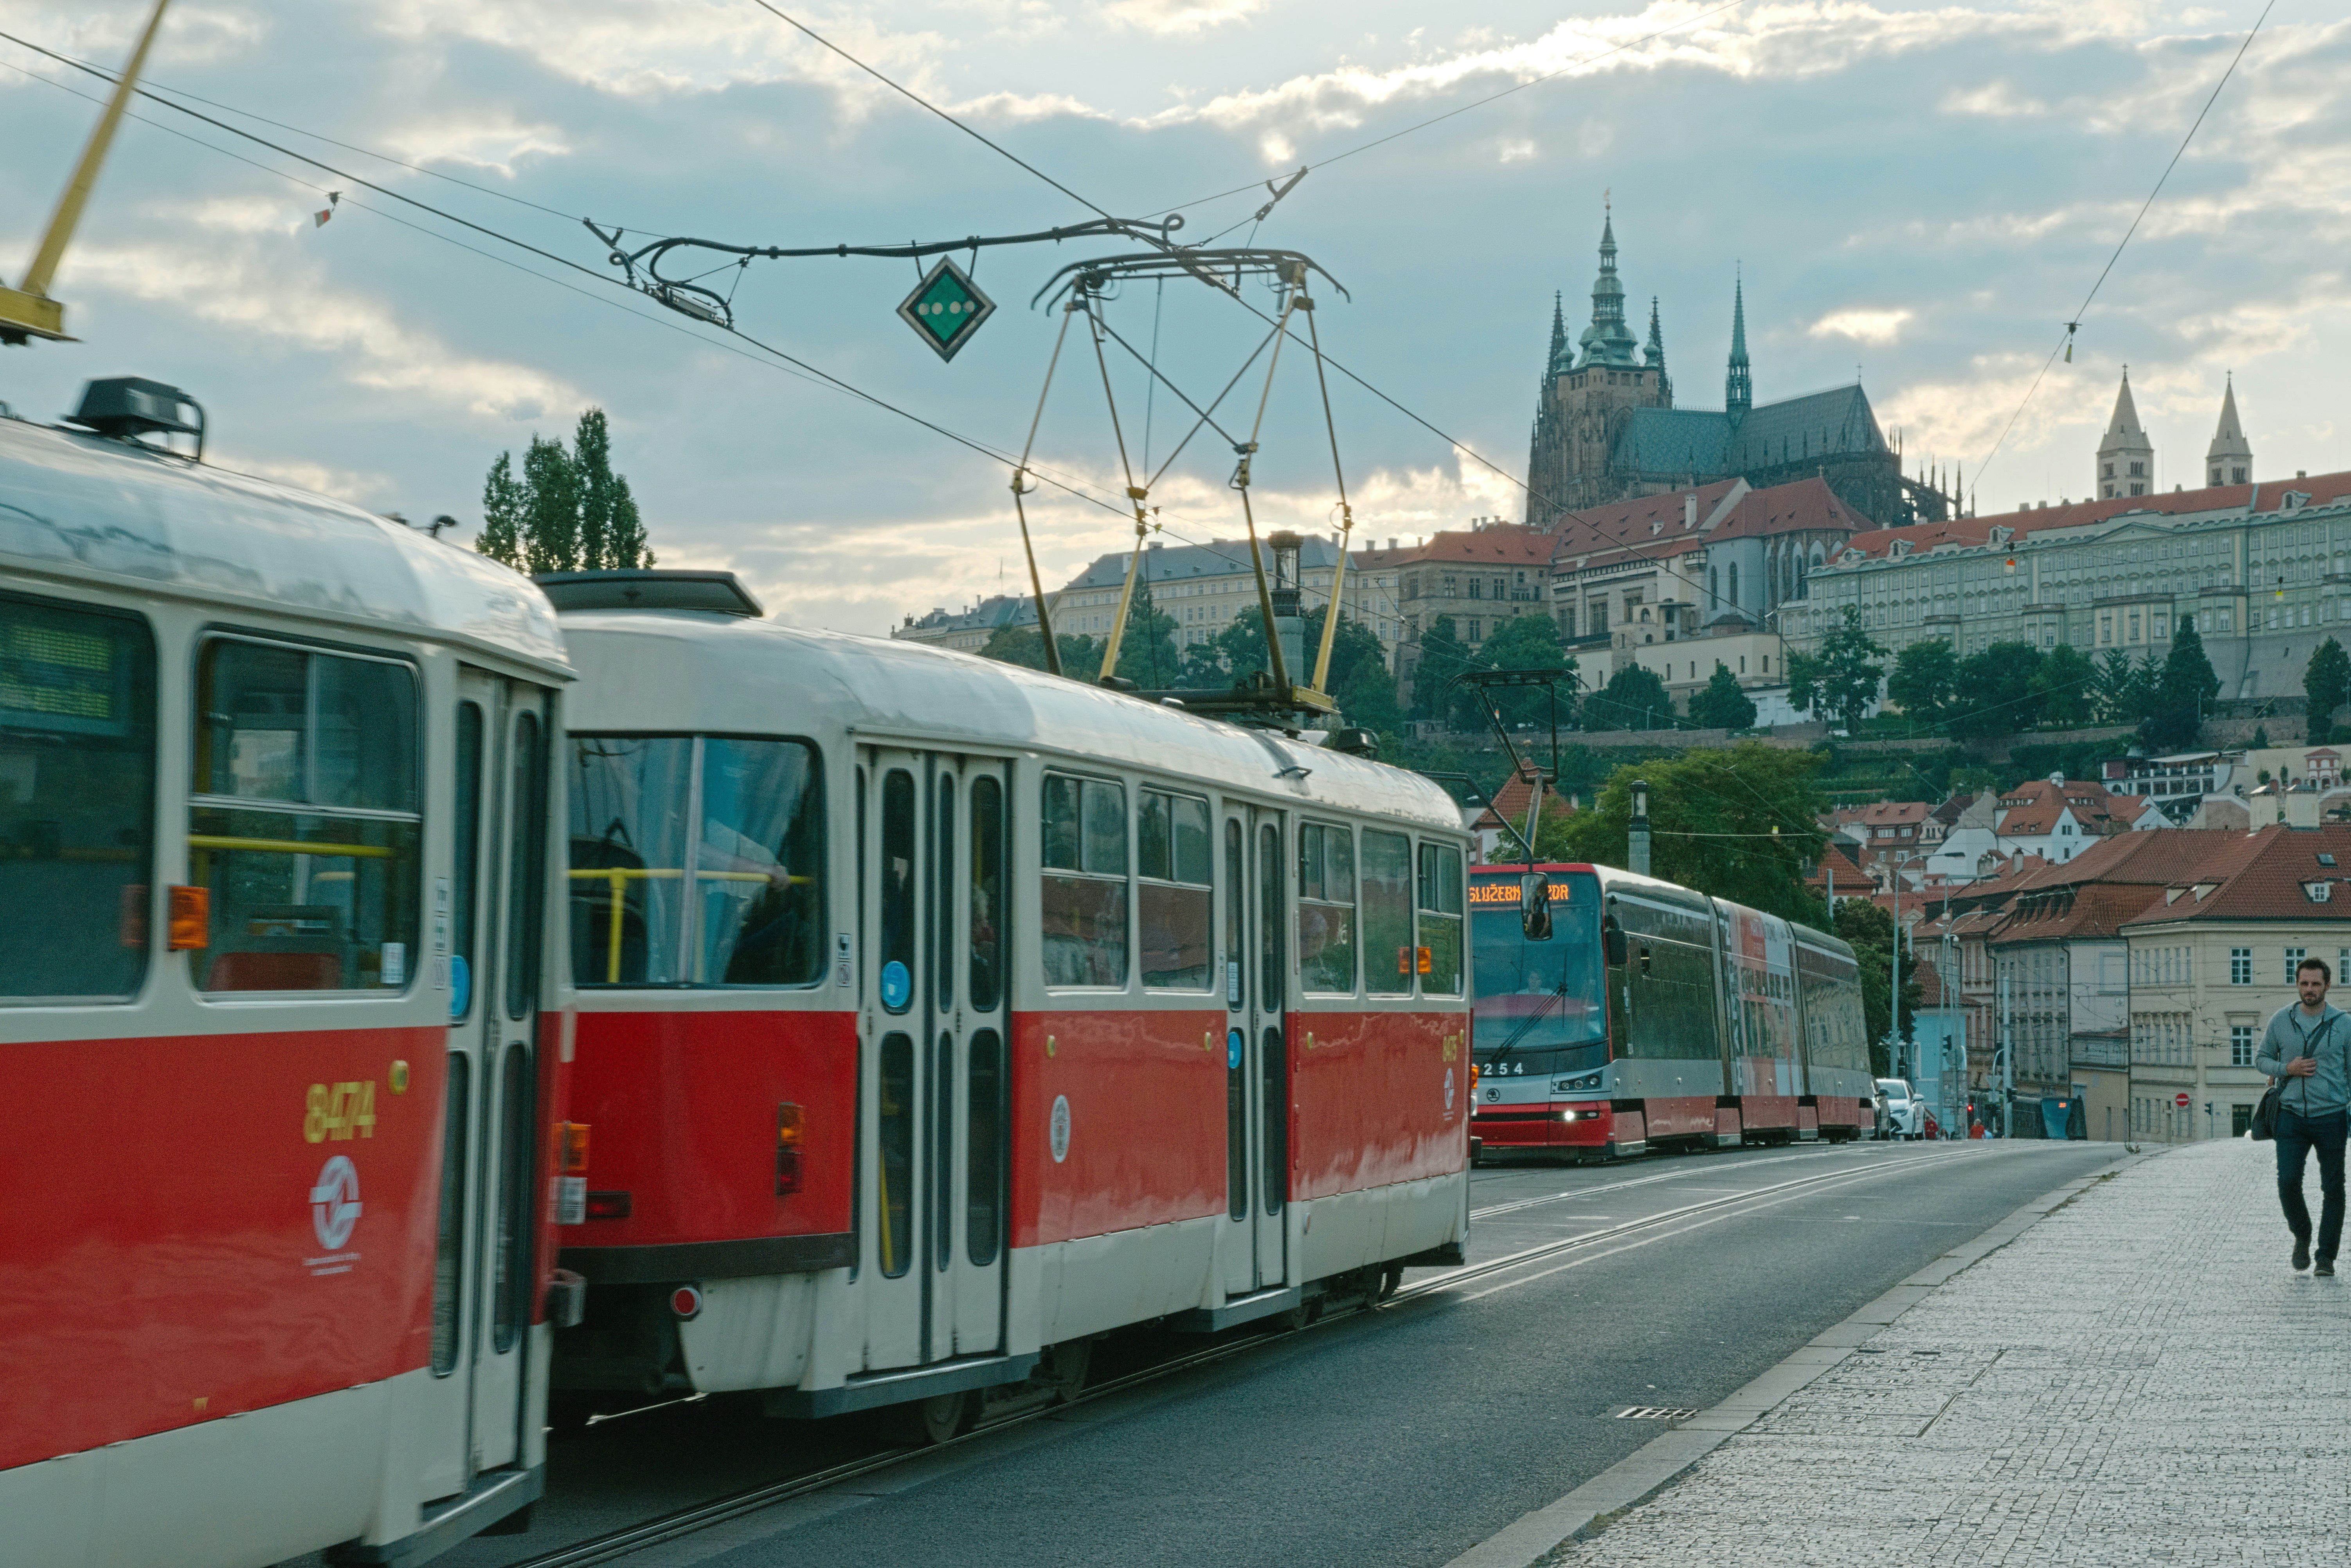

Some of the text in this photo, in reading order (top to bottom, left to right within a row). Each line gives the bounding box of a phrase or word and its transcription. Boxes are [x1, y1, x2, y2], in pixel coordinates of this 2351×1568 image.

[1469, 883, 1521, 902] SLUŽEBN
[1471, 1063, 1523, 1075] 254
[304, 1081, 376, 1143] 8474
